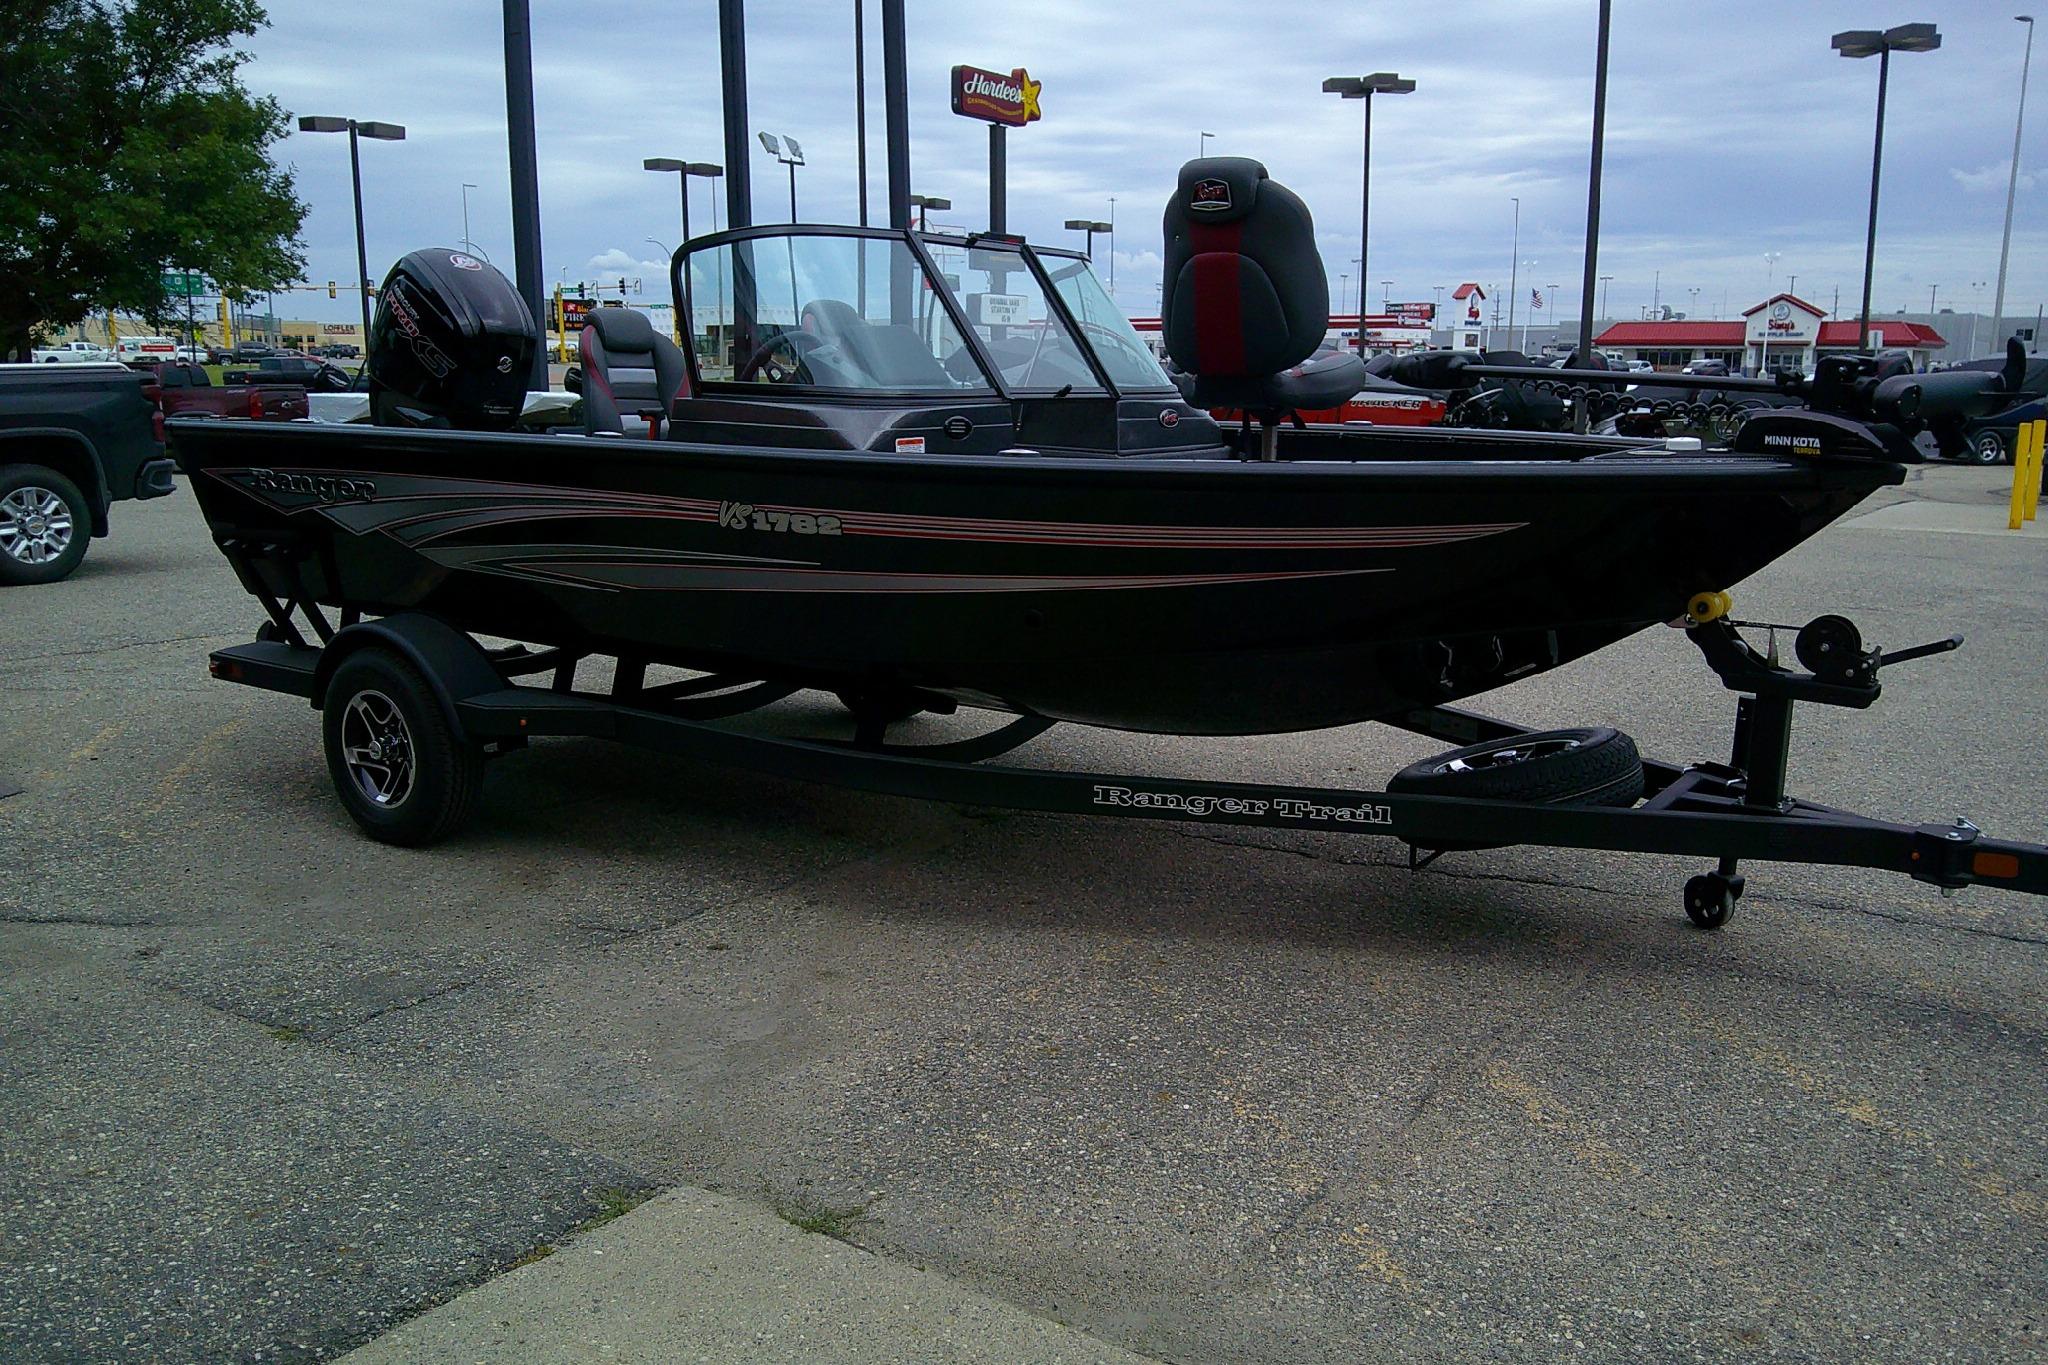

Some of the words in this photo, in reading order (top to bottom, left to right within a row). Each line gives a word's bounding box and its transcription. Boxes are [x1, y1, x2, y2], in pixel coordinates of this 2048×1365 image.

[964, 73, 1022, 103] Hardee's
[323, 324, 355, 332] LOFFLER
[385, 290, 420, 337] PRO
[394, 327, 458, 378] XS
[1349, 399, 1423, 410] TRACKER
[1764, 434, 1791, 446] MINN
[1792, 436, 1821, 448] KOTA
[249, 468, 377, 504] Ranger
[1093, 785, 1269, 815] Ranger
[1273, 798, 1393, 824] Trail
